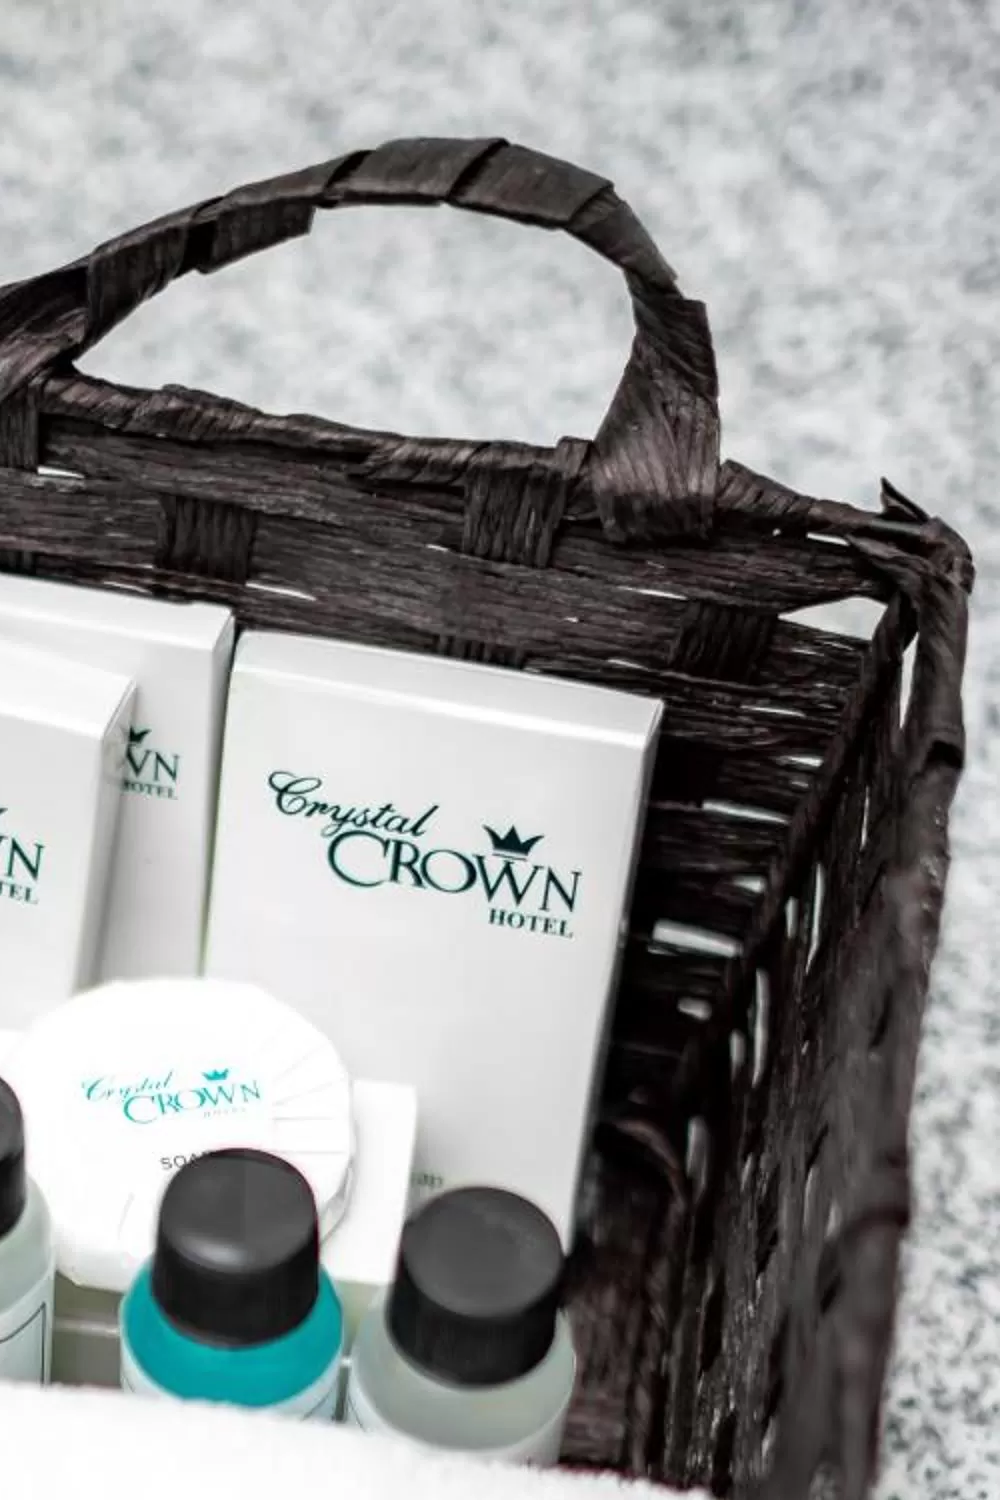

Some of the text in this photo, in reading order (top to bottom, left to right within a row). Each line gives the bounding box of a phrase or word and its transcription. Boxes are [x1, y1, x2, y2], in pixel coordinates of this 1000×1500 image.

[268, 771, 439, 837] Crystal
[327, 830, 582, 913] CROWN
[488, 908, 573, 939] HOTEL
[123, 1079, 261, 1124] CROWN
